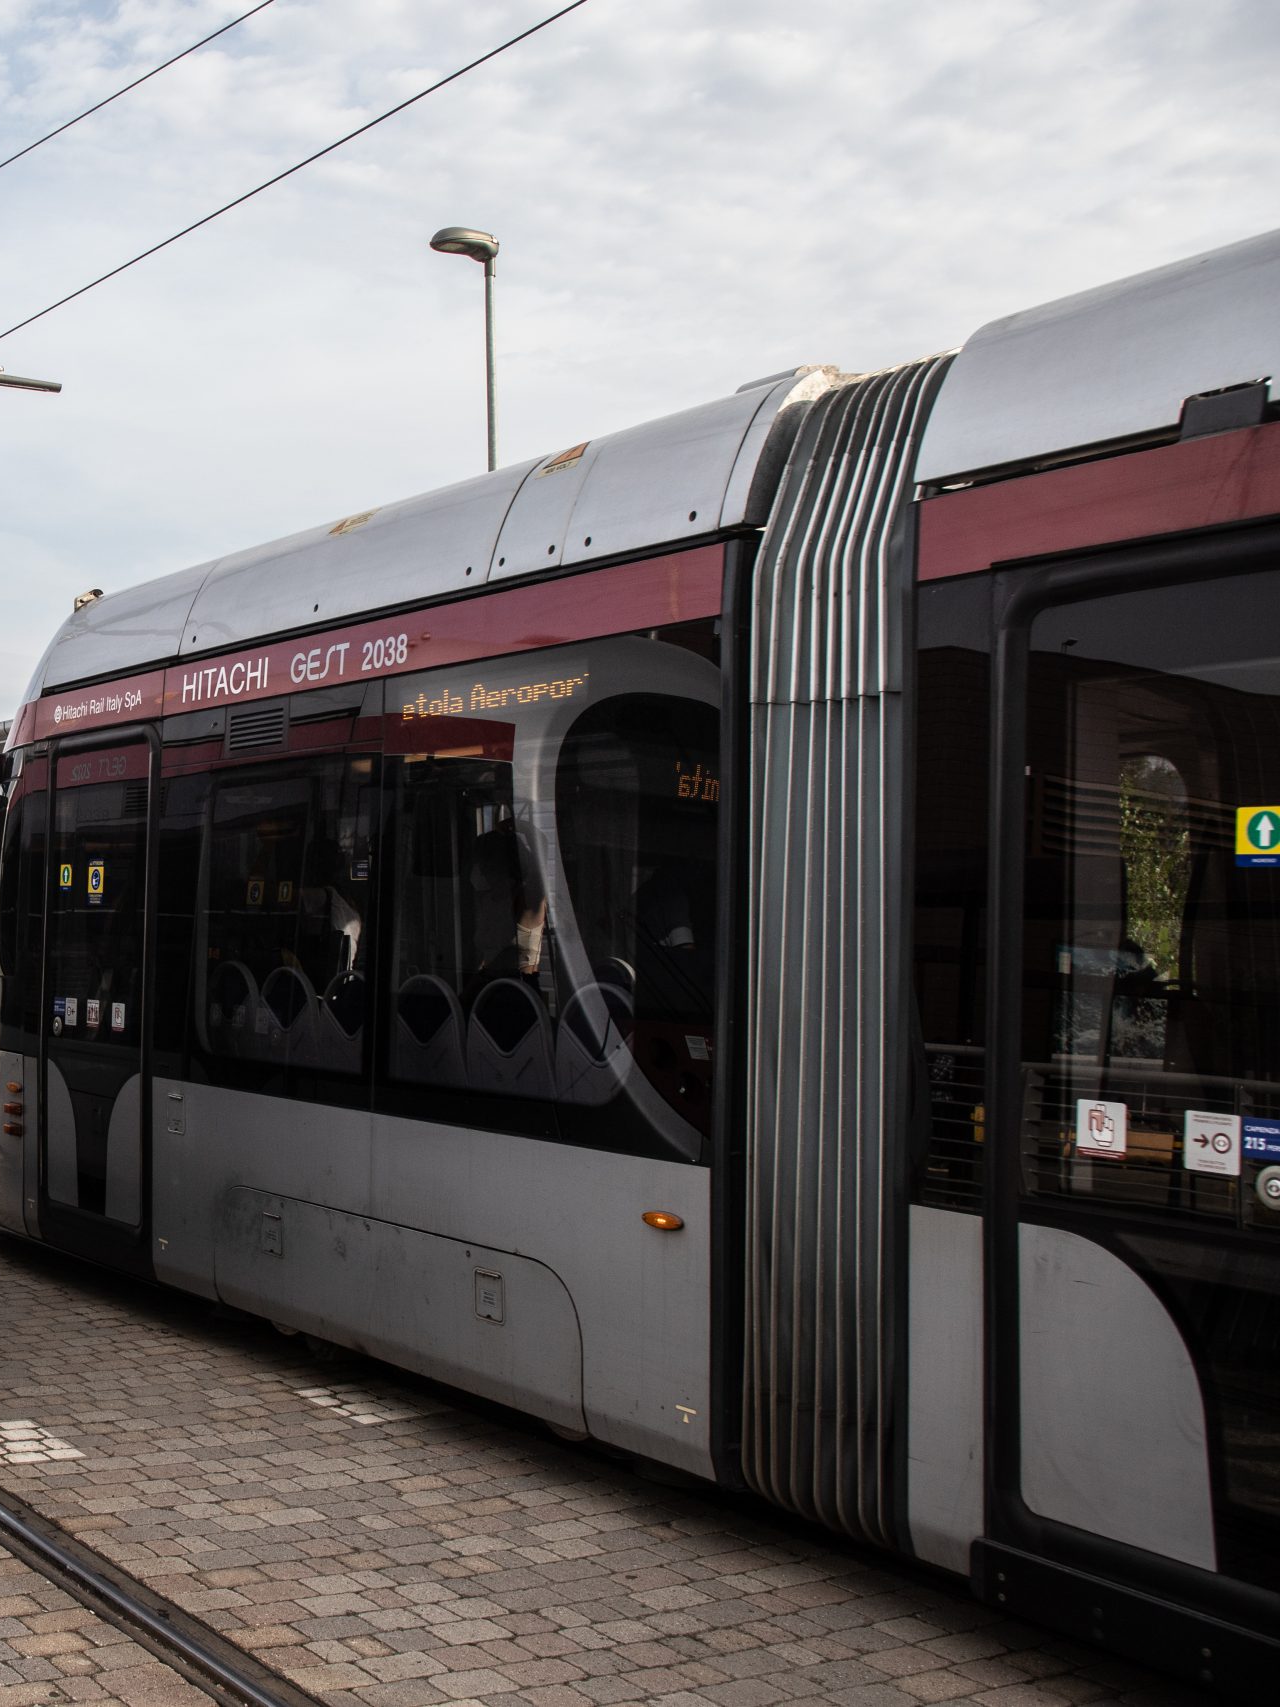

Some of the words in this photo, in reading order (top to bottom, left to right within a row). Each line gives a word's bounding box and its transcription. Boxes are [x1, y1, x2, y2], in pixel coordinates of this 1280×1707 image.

[182, 656, 269, 703] HITACHI
[290, 642, 350, 684] GEST
[361, 633, 408, 672] 2038
[62, 702, 88, 720] Hitachi
[89, 698, 105, 715] Rail
[106, 694, 123, 713] Italy
[124, 689, 142, 711] SpA
[471, 673, 590, 710] Aeropor
[1244, 1136, 1266, 1151] 215
